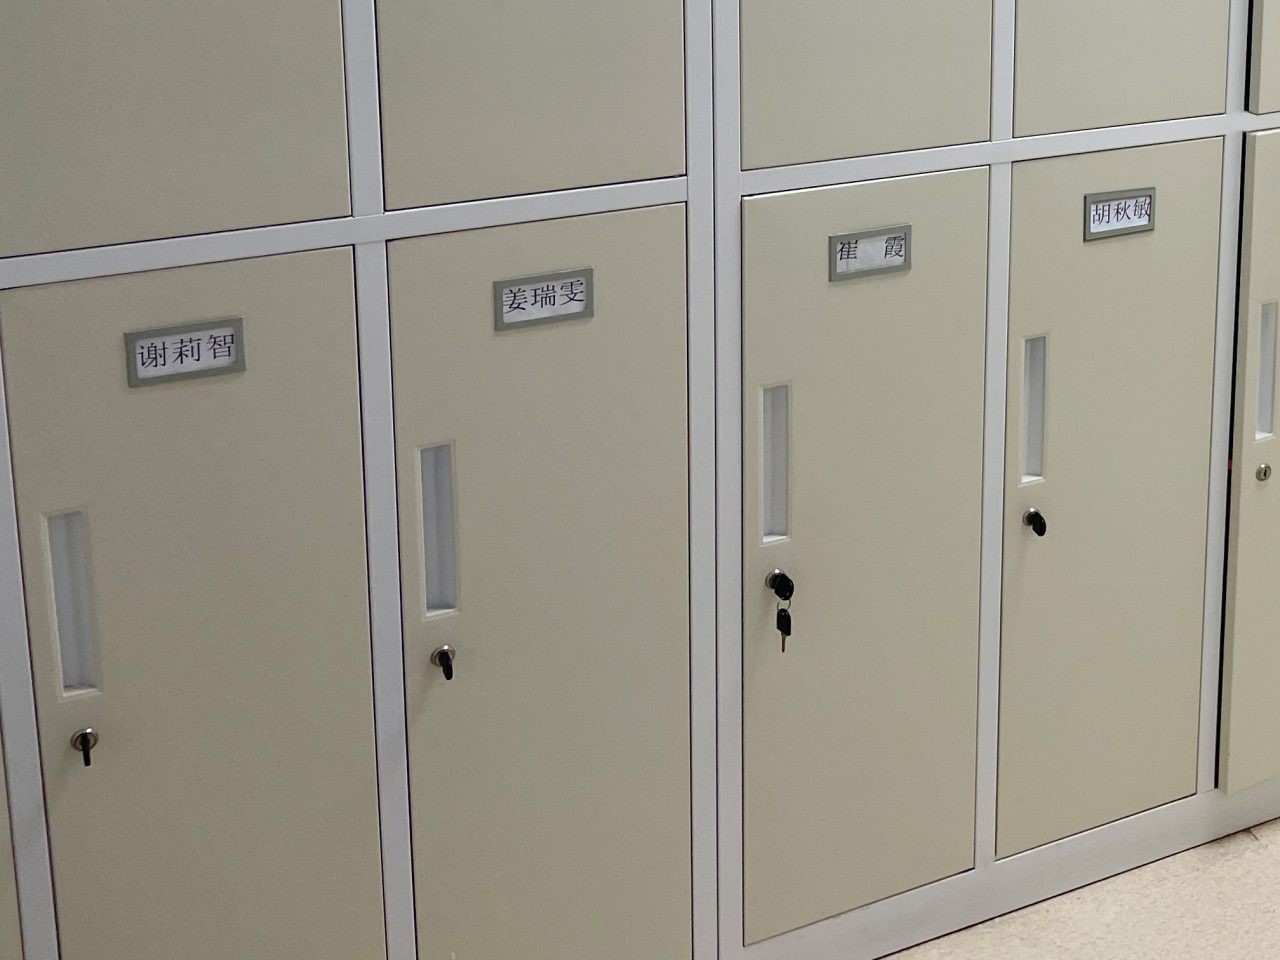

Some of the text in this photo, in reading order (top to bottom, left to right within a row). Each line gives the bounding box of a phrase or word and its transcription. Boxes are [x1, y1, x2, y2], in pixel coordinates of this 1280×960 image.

[1092, 198, 1152, 225] 胡秋敏
[504, 279, 585, 314] 姜瑞雯
[138, 334, 235, 369] 谢莉智
